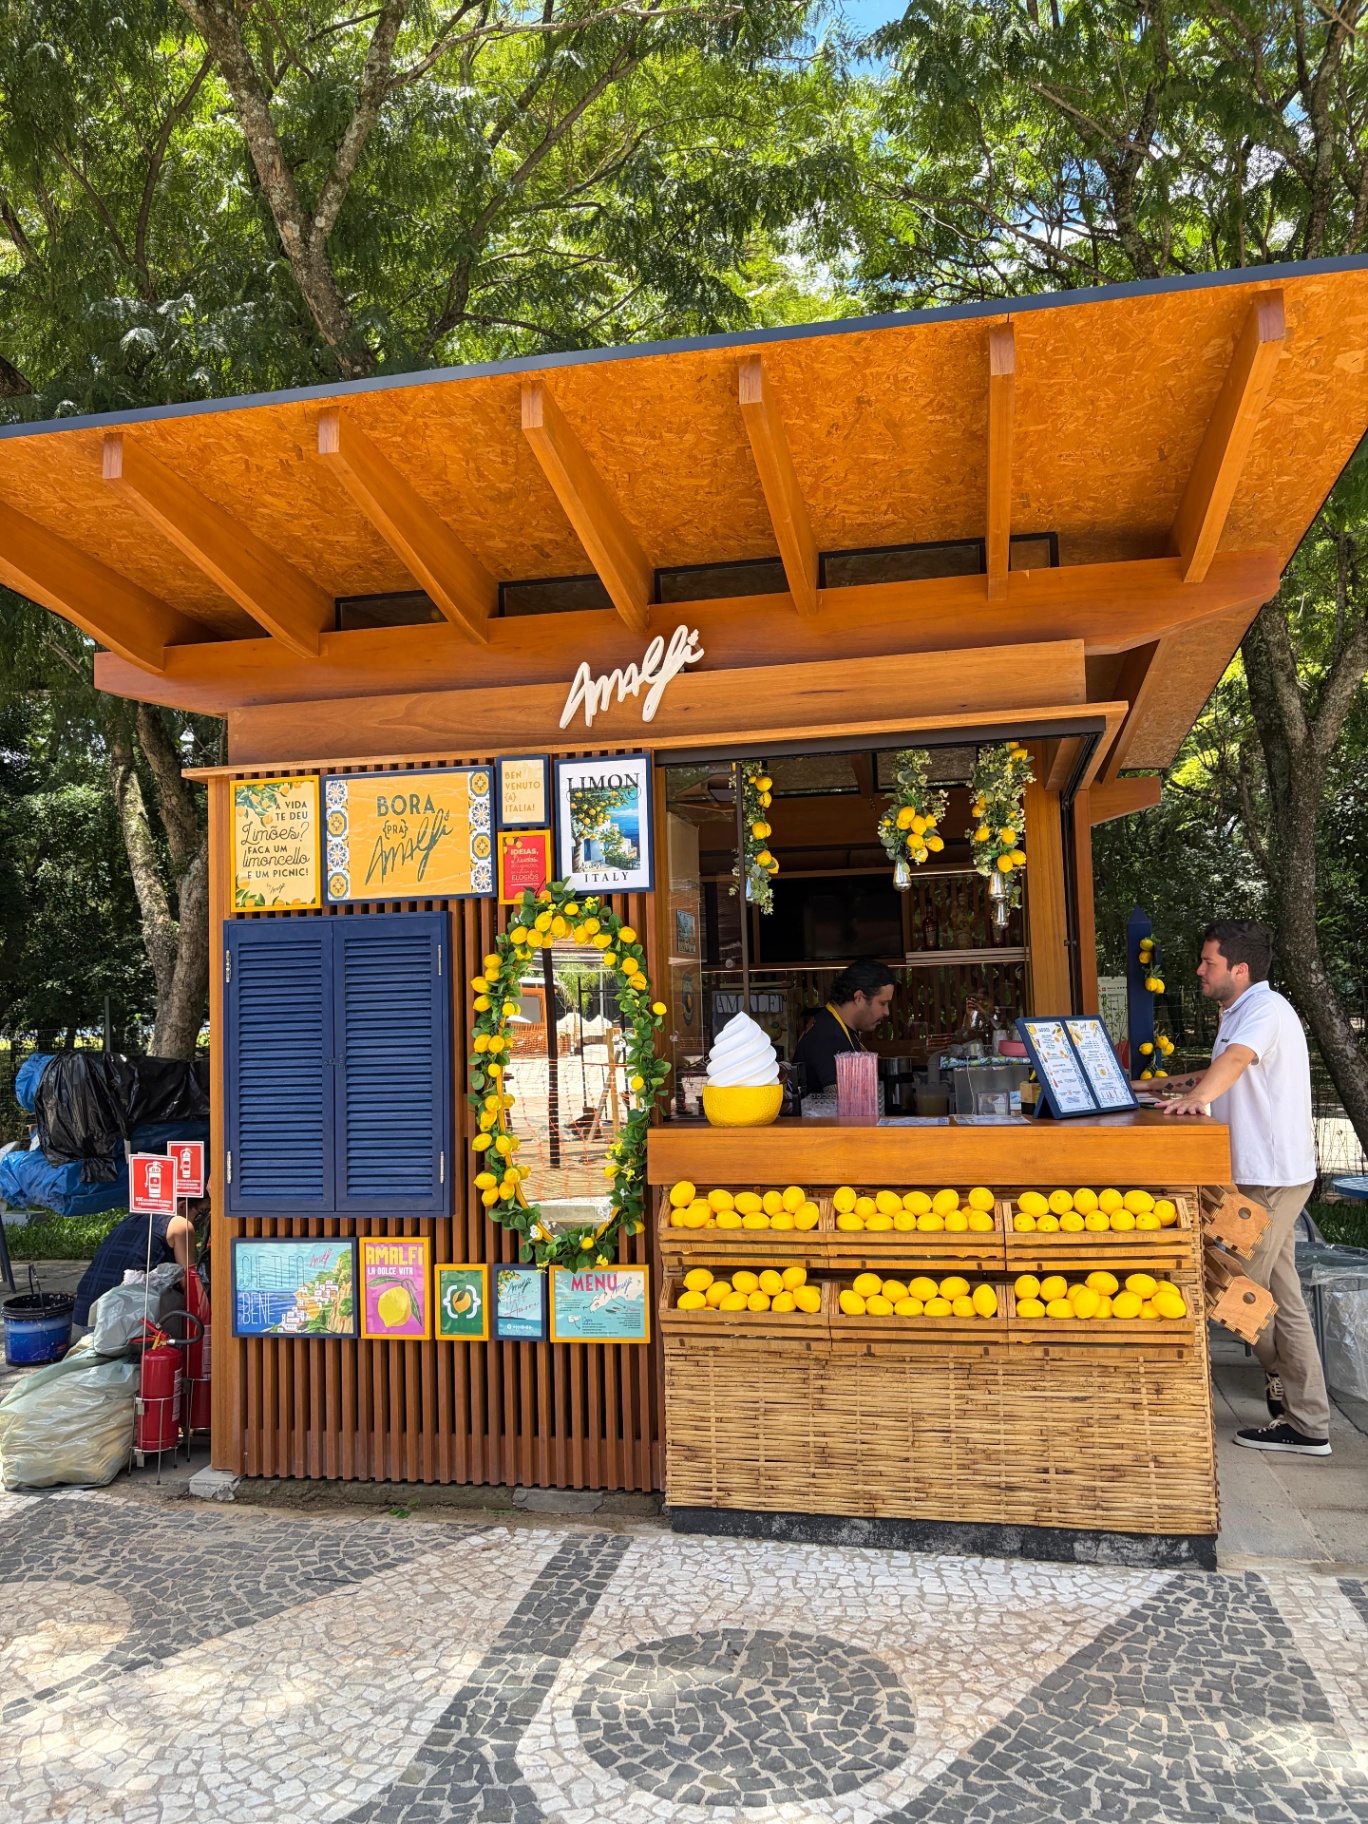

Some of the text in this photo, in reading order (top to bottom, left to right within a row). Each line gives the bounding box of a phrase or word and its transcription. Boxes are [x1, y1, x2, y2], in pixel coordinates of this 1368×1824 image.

[504, 771, 522, 780] BEN
[504, 781, 541, 790] VENUTO
[566, 773, 640, 792] LIMON
[275, 800, 308, 810] A VIDA
[376, 793, 435, 817] BORA
[504, 803, 535, 813] ITALIA!
[275, 811, 308, 821] TE DEU
[240, 821, 310, 846] Limões?
[273, 844, 288, 854] UM
[510, 847, 539, 856] IDEIAS,
[242, 846, 311, 868] limoncello
[247, 867, 309, 880] E UM PICNIC!
[511, 873, 539, 881] ELOGIOS
[584, 871, 629, 883] ITALY
[365, 1246, 424, 1266] AMALFI
[367, 1267, 414, 1276] LA DOLCE VITA
[570, 1273, 618, 1292] MENU
[242, 1292, 276, 1325] BENE
